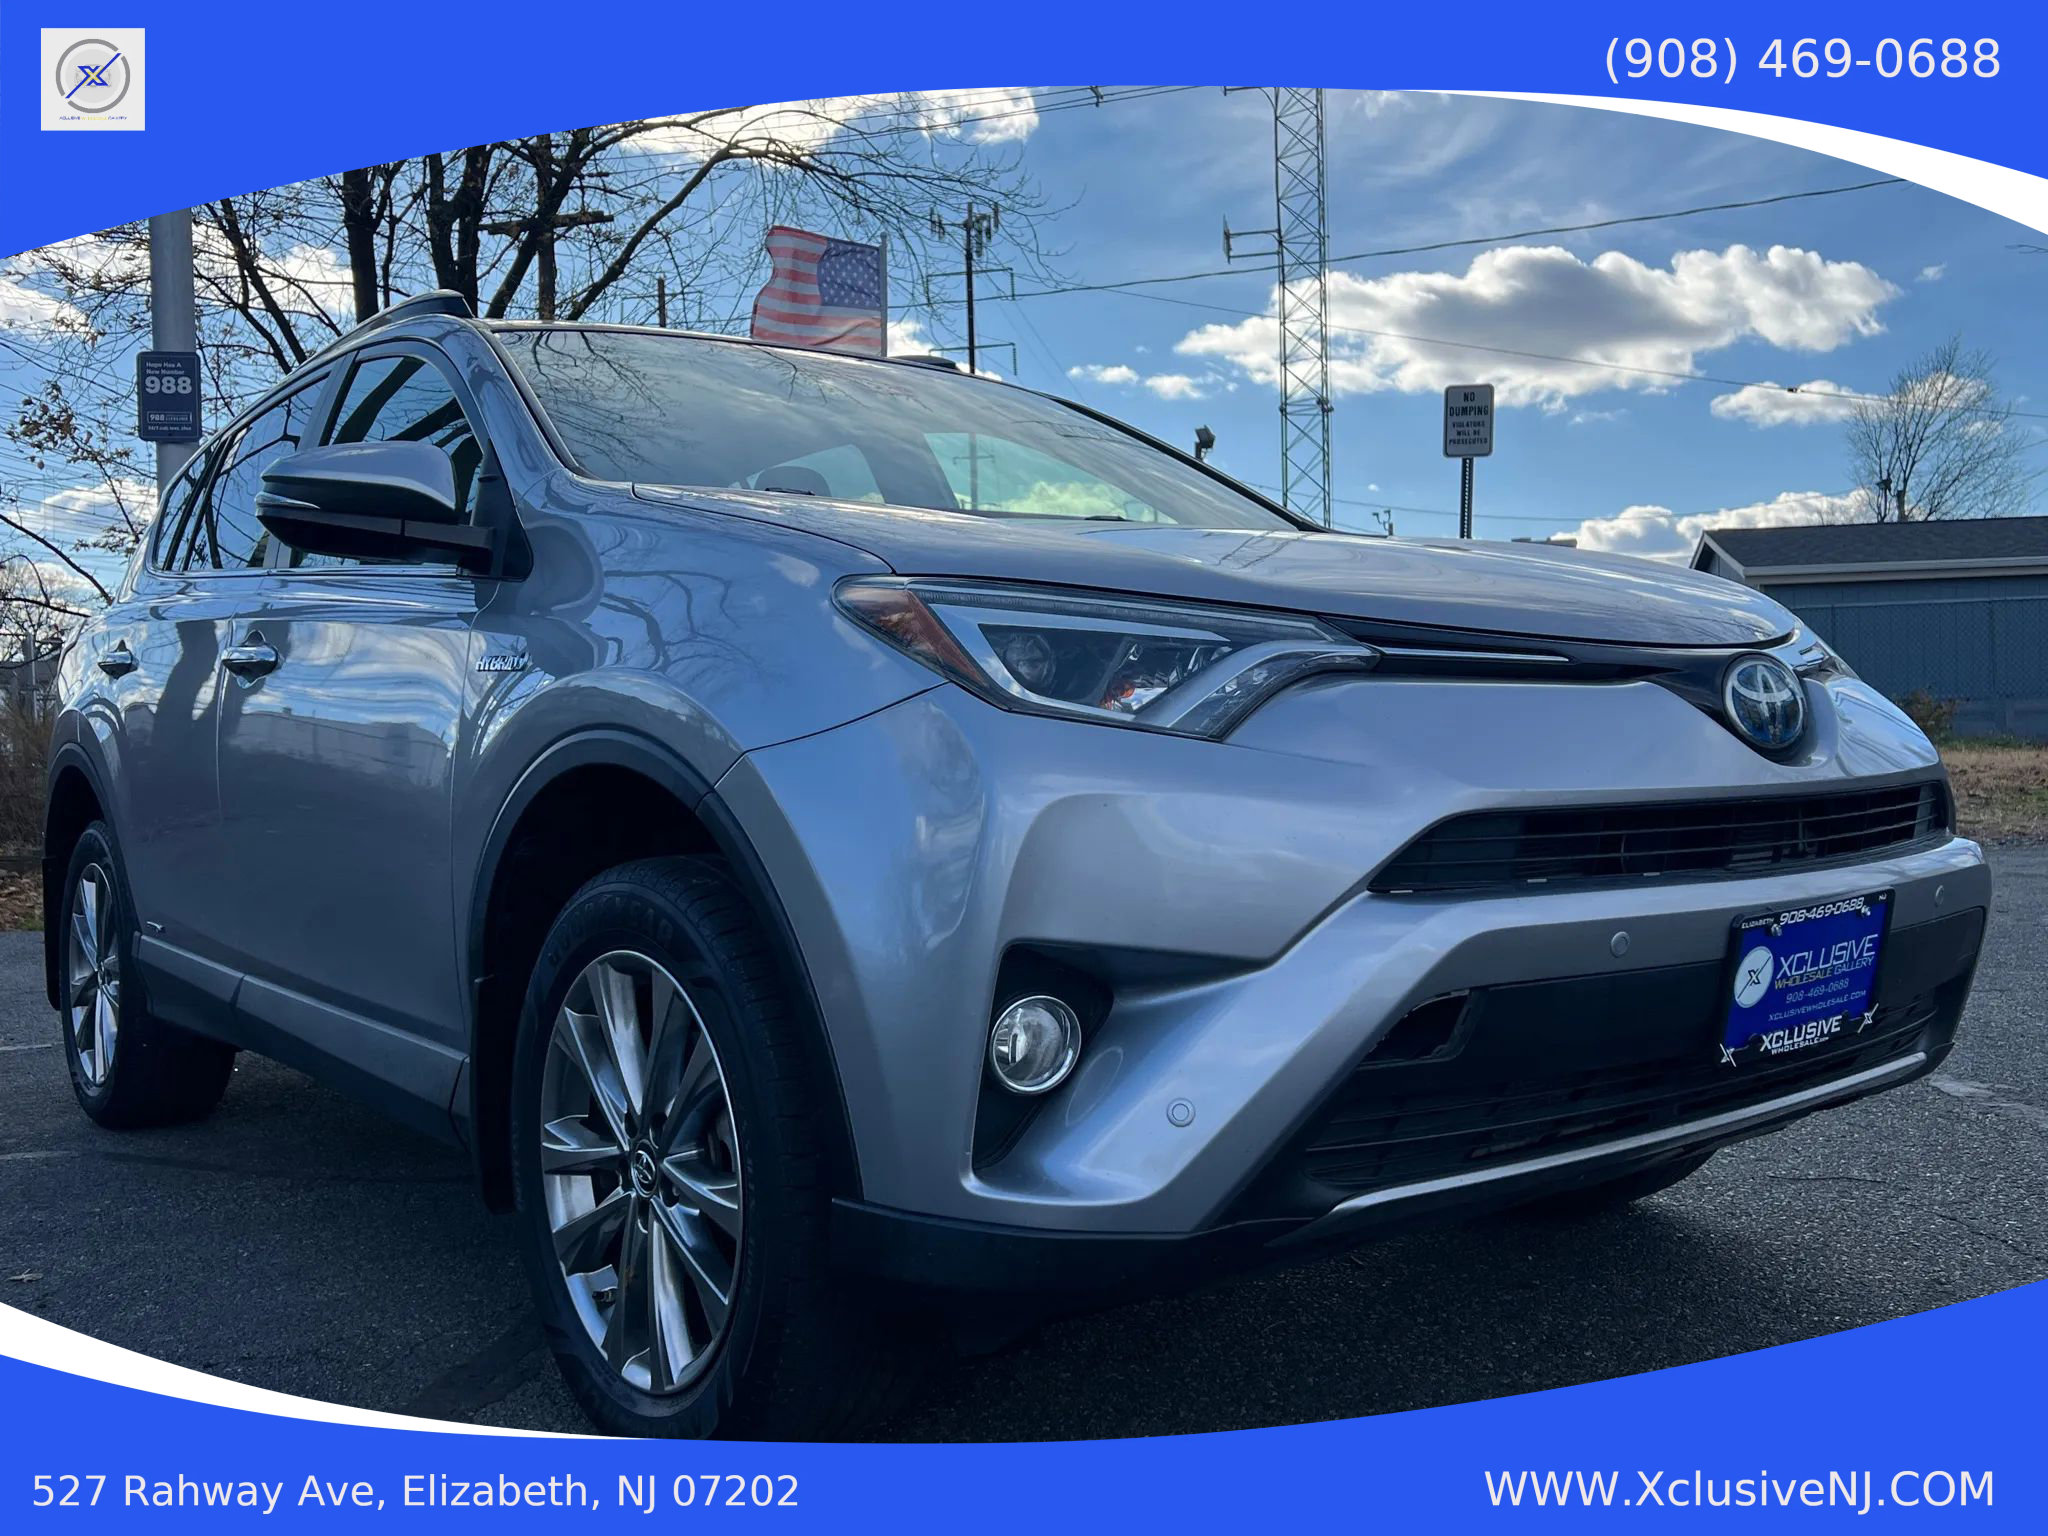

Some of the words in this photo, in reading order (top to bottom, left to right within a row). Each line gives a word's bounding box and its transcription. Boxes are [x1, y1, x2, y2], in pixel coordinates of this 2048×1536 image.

[145, 376, 192, 394] 988
[1464, 392, 1475, 402] NO
[1449, 405, 1489, 417] DUMPING
[1741, 917, 1775, 929] ELIZABETH
[1780, 896, 1865, 925] 908-469-0688
[1776, 933, 1878, 980] XCLUSIVE
[1774, 966, 1833, 990] WHOLESALE
[1833, 955, 1875, 975] GALLERY
[1785, 977, 1850, 1004] 908-469-0688
[1760, 1014, 1843, 1052] XCLUSIVE
